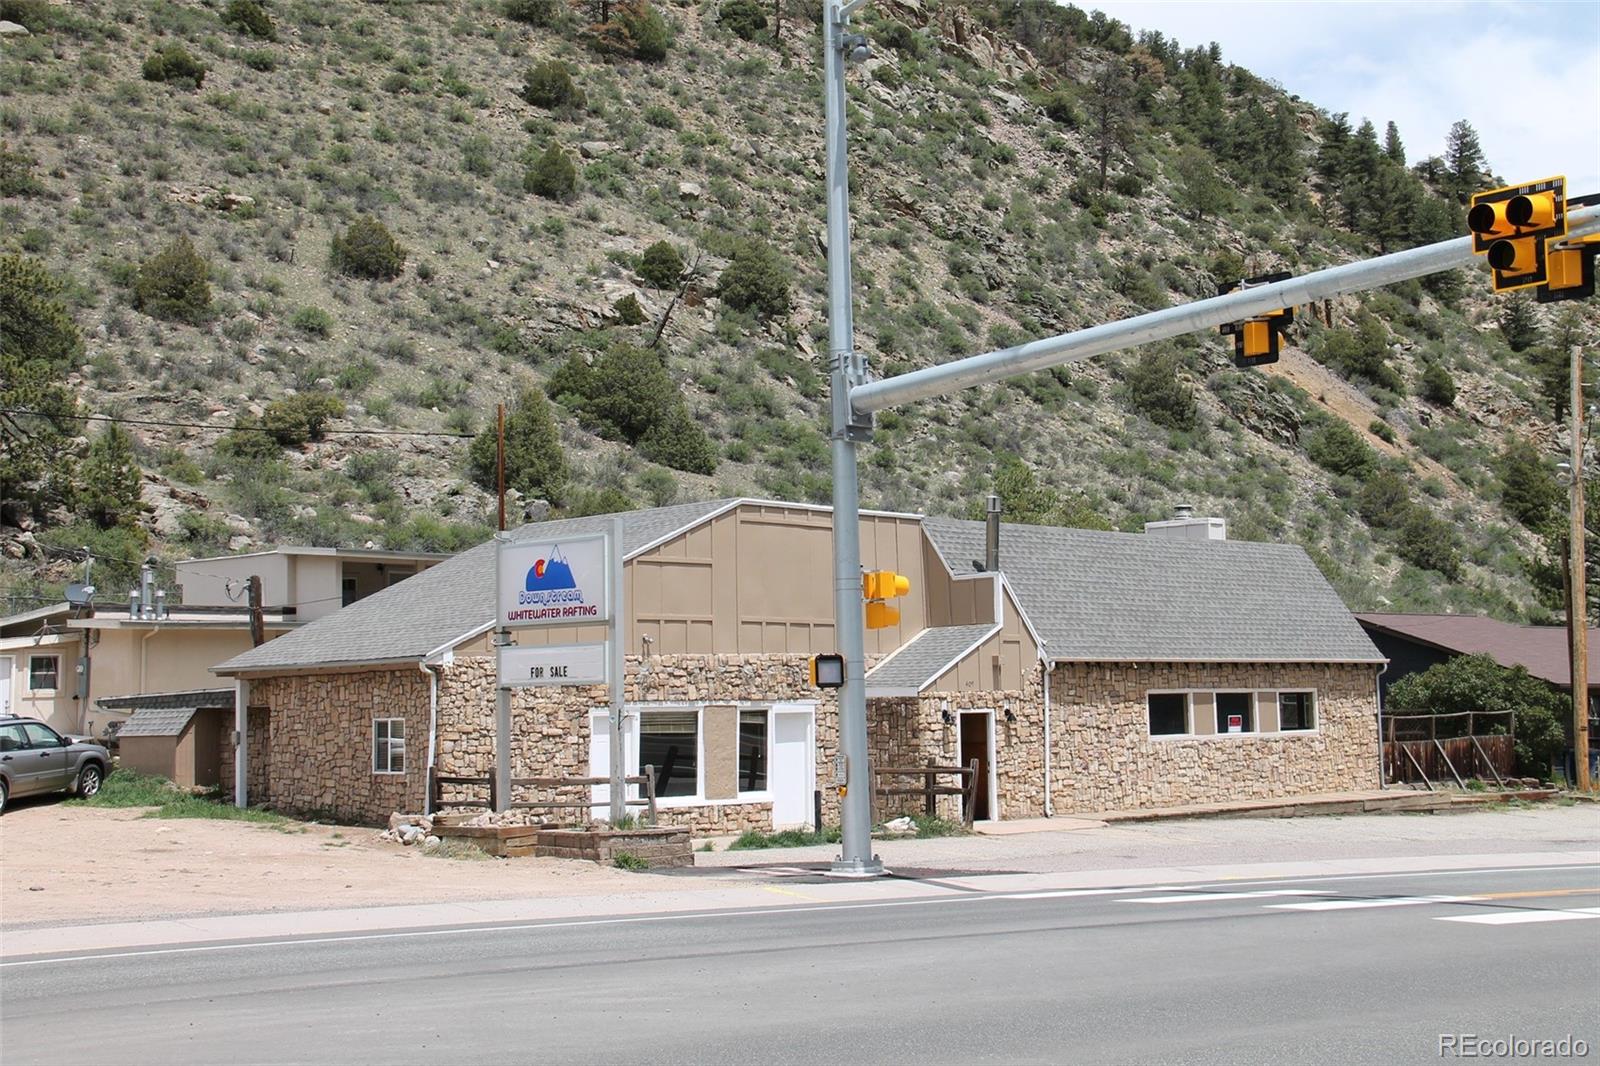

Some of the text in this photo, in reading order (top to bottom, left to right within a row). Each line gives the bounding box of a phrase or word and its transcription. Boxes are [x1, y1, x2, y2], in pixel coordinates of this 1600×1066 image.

[508, 605, 597, 621] WHITEWATER RAFTING
[530, 666, 568, 678] FOR SALE
